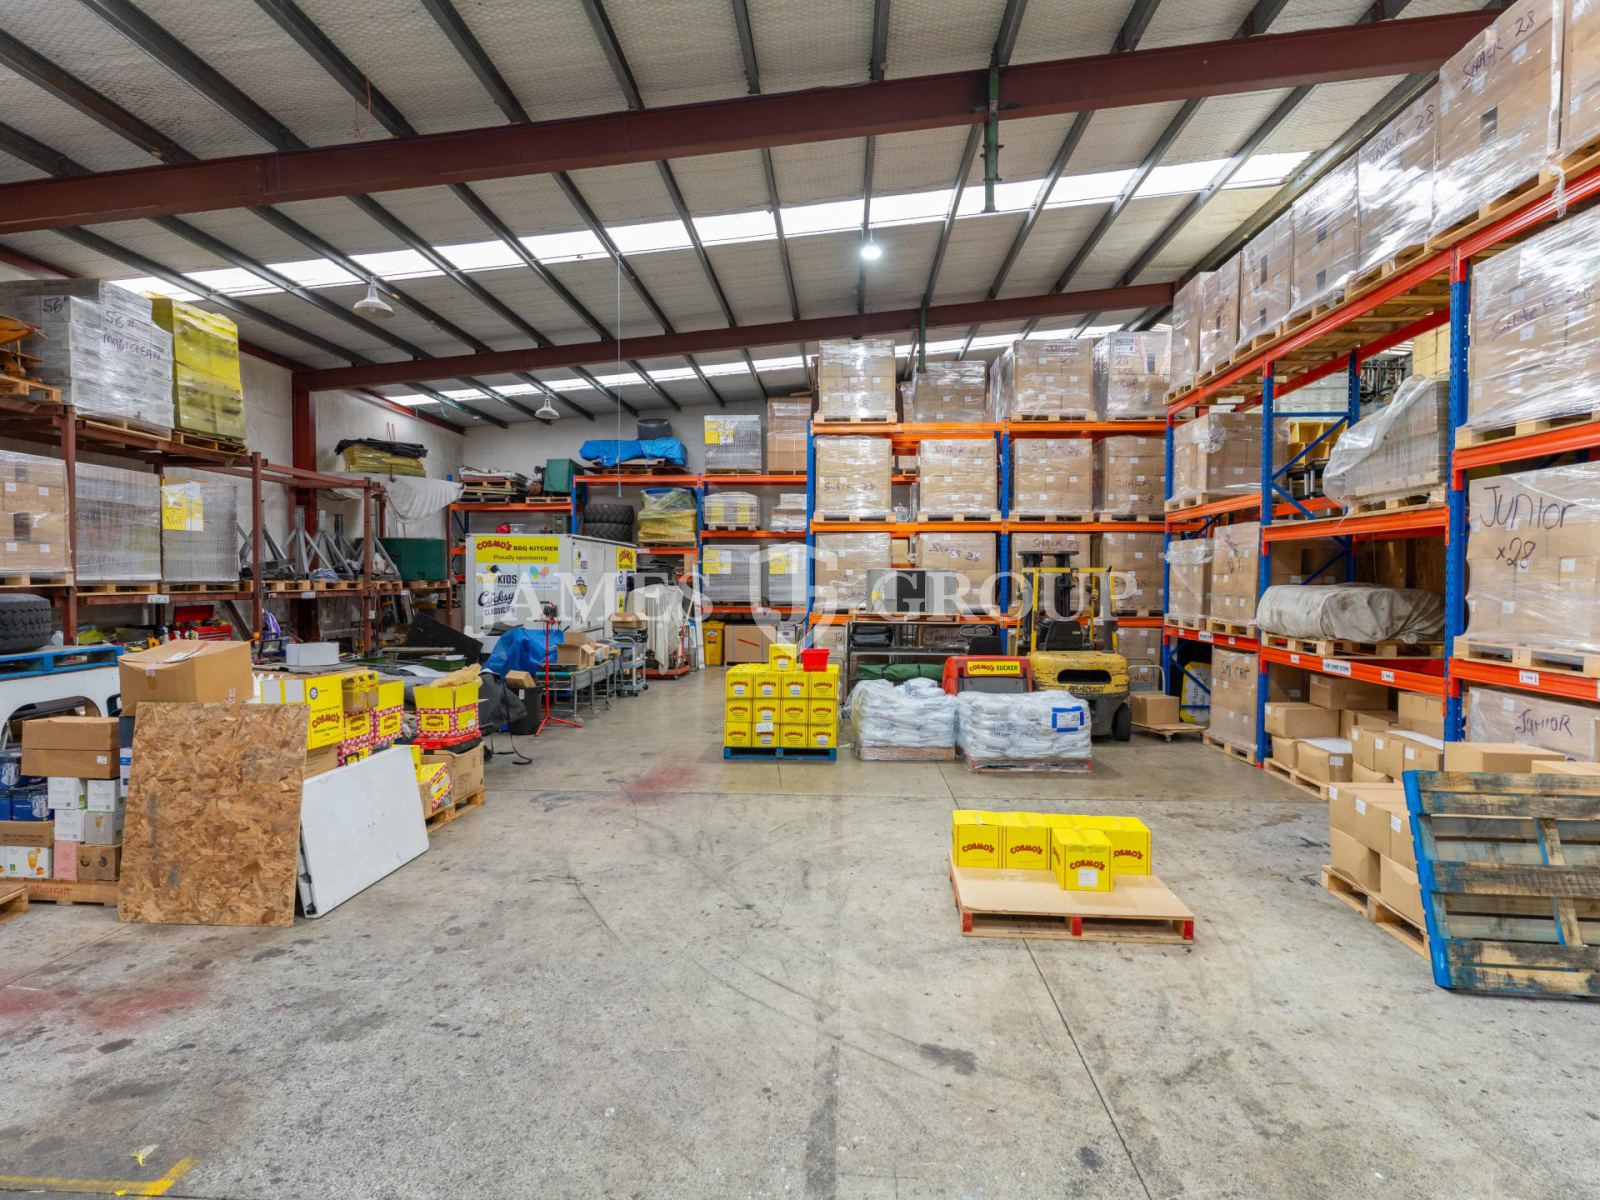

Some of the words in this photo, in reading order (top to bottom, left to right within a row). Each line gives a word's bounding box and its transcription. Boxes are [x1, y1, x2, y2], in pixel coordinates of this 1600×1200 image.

[1514, 9, 1535, 37] 28
[1415, 104, 1434, 130] 28
[513, 544, 528, 552] BBQ
[497, 574, 517, 585] KIDS
[1113, 849, 1143, 860] OSMO'S
